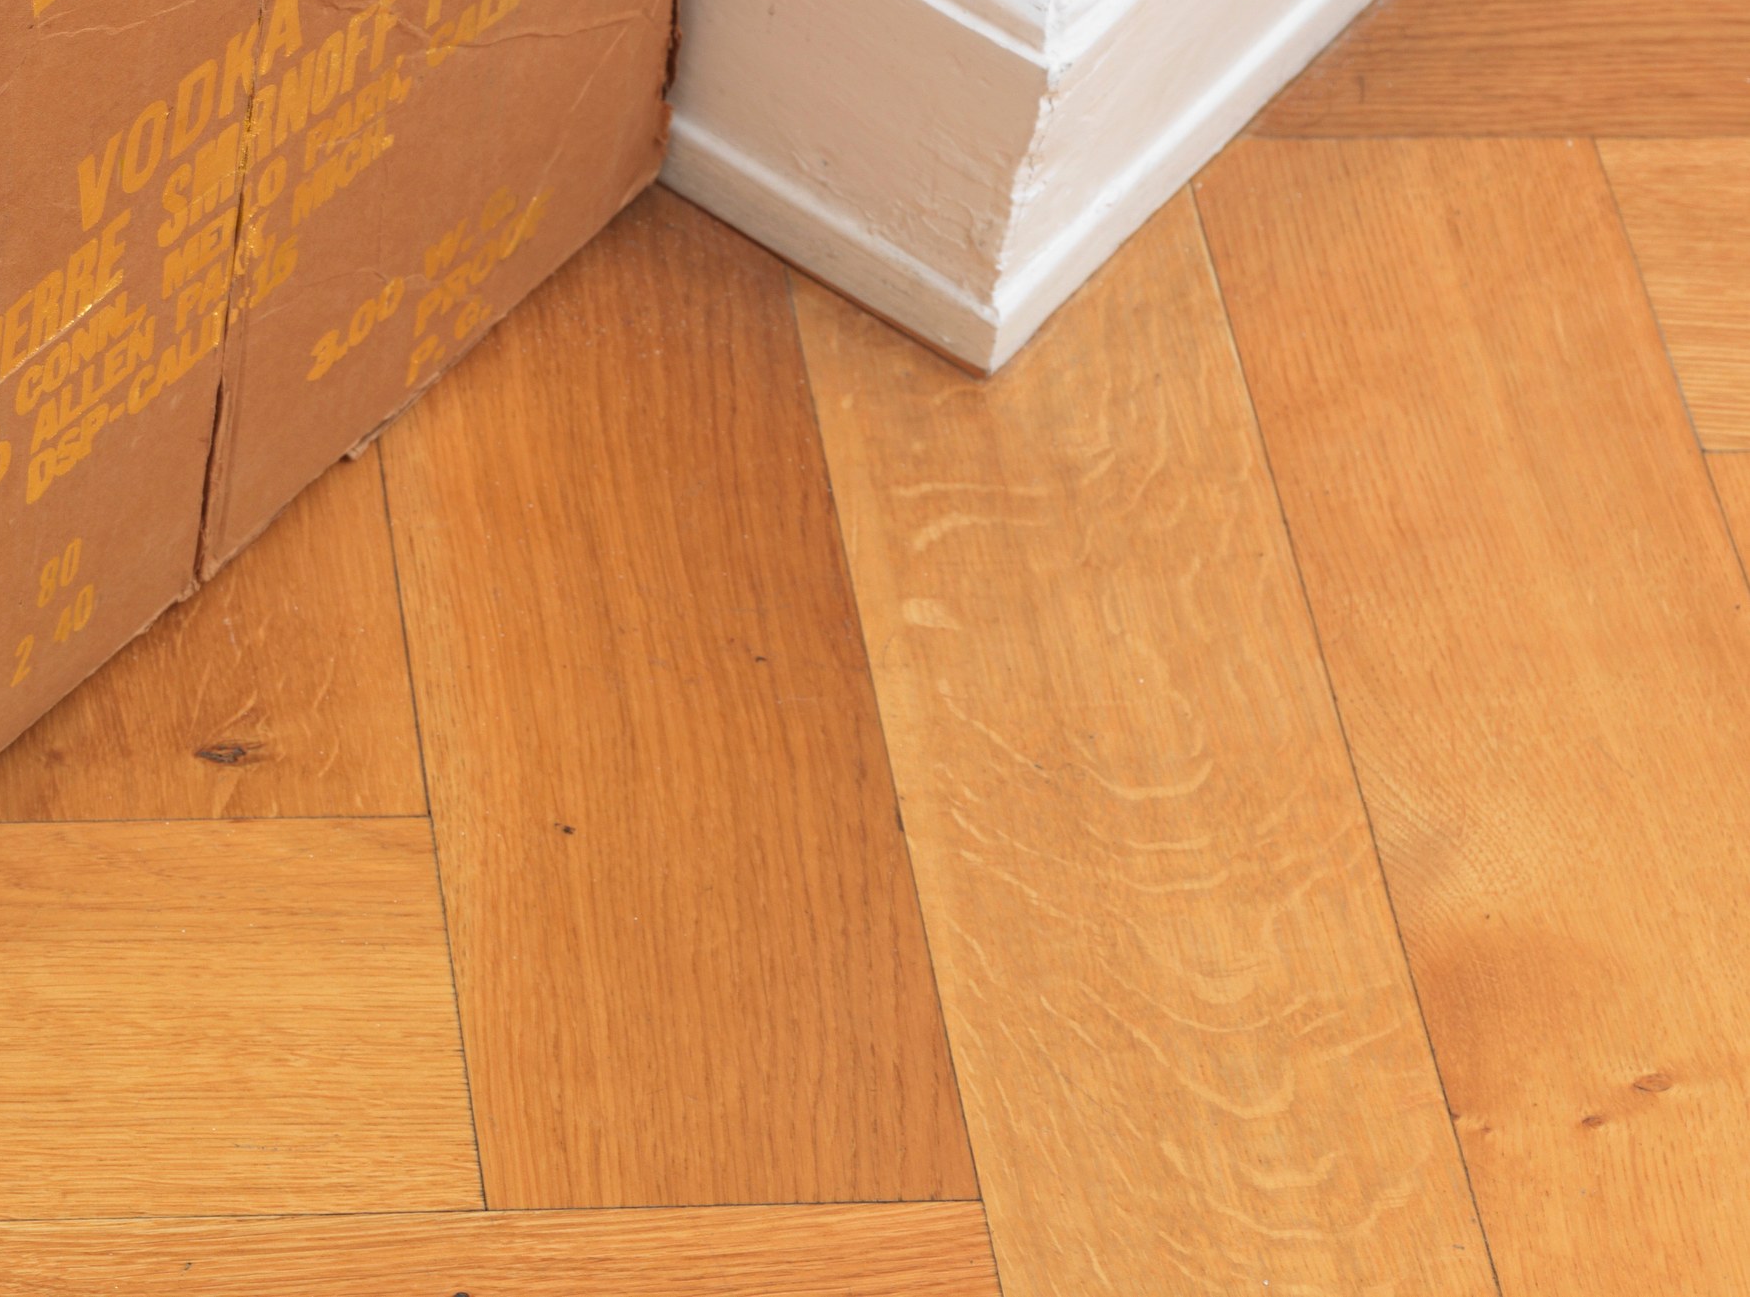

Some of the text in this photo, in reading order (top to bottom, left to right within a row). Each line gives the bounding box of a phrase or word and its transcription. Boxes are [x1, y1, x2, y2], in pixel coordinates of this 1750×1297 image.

[31, 316, 155, 454] ALLEN
[292, 118, 394, 228] MICH.
[37, 538, 82, 608] 80
